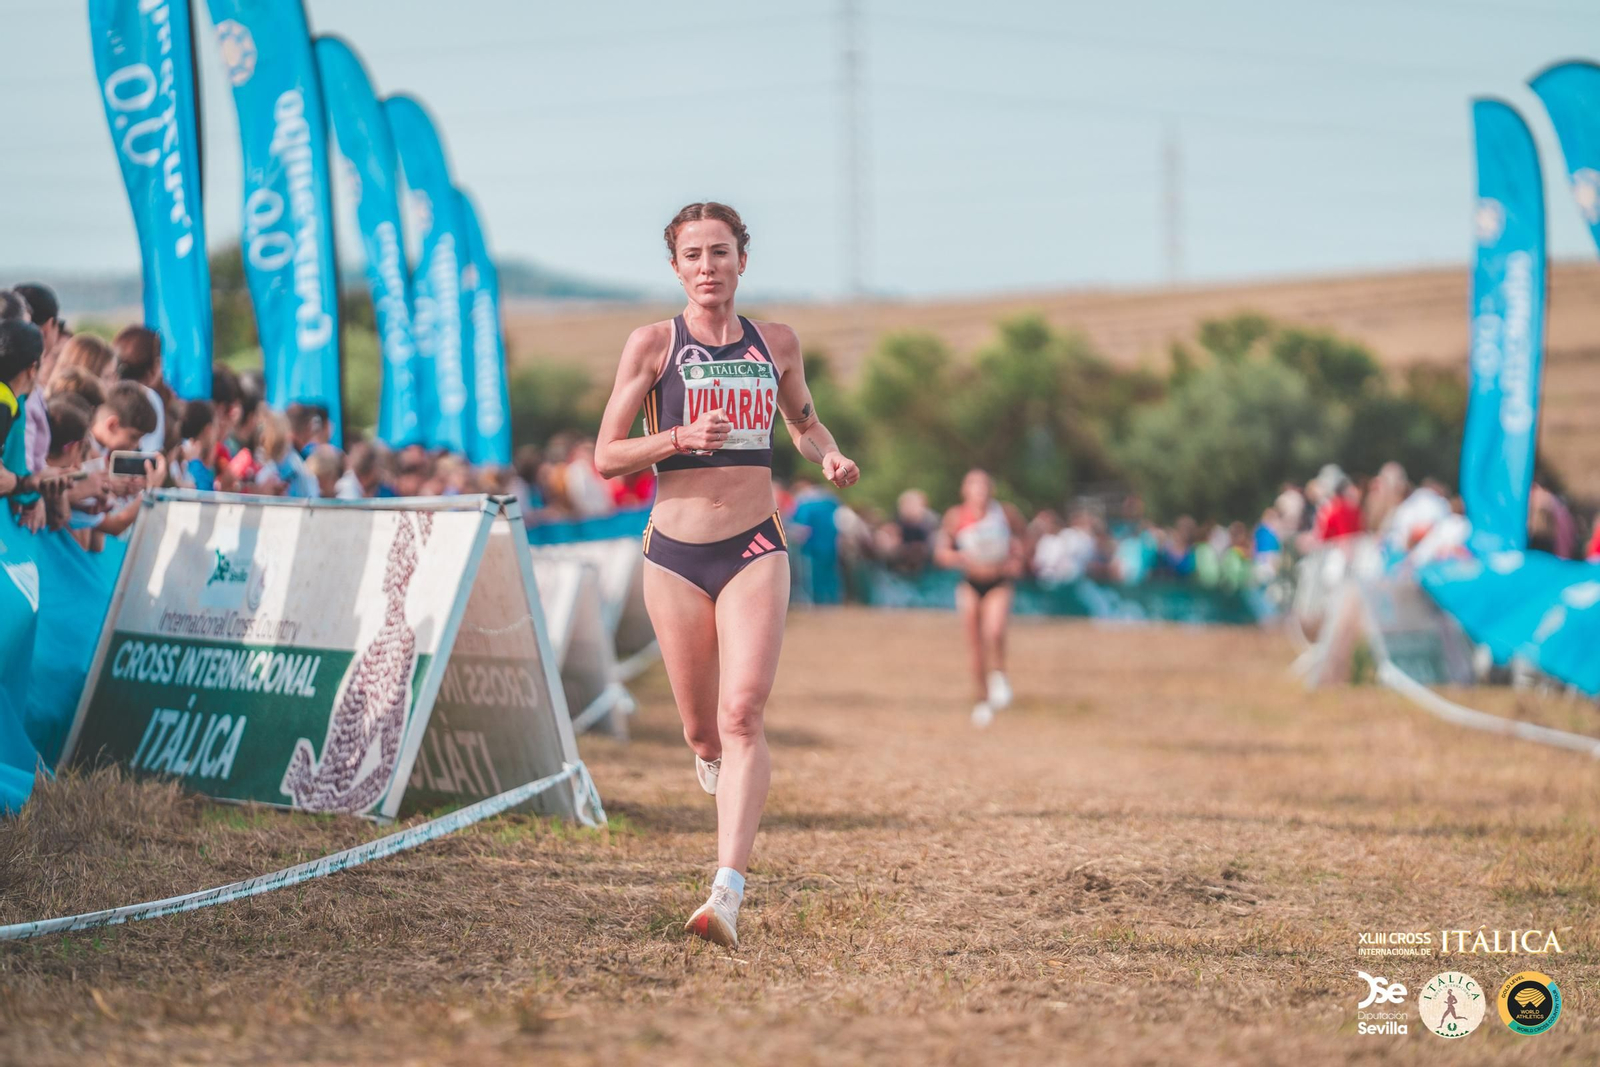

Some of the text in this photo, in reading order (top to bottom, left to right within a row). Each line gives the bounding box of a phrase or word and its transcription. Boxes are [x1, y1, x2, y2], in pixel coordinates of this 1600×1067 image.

[709, 363, 754, 375] ITÁLICA
[688, 378, 774, 430] VIÑARÁS
[111, 639, 321, 698] CROSS INTERNACIONAL
[129, 693, 247, 781] ITÁLICA
